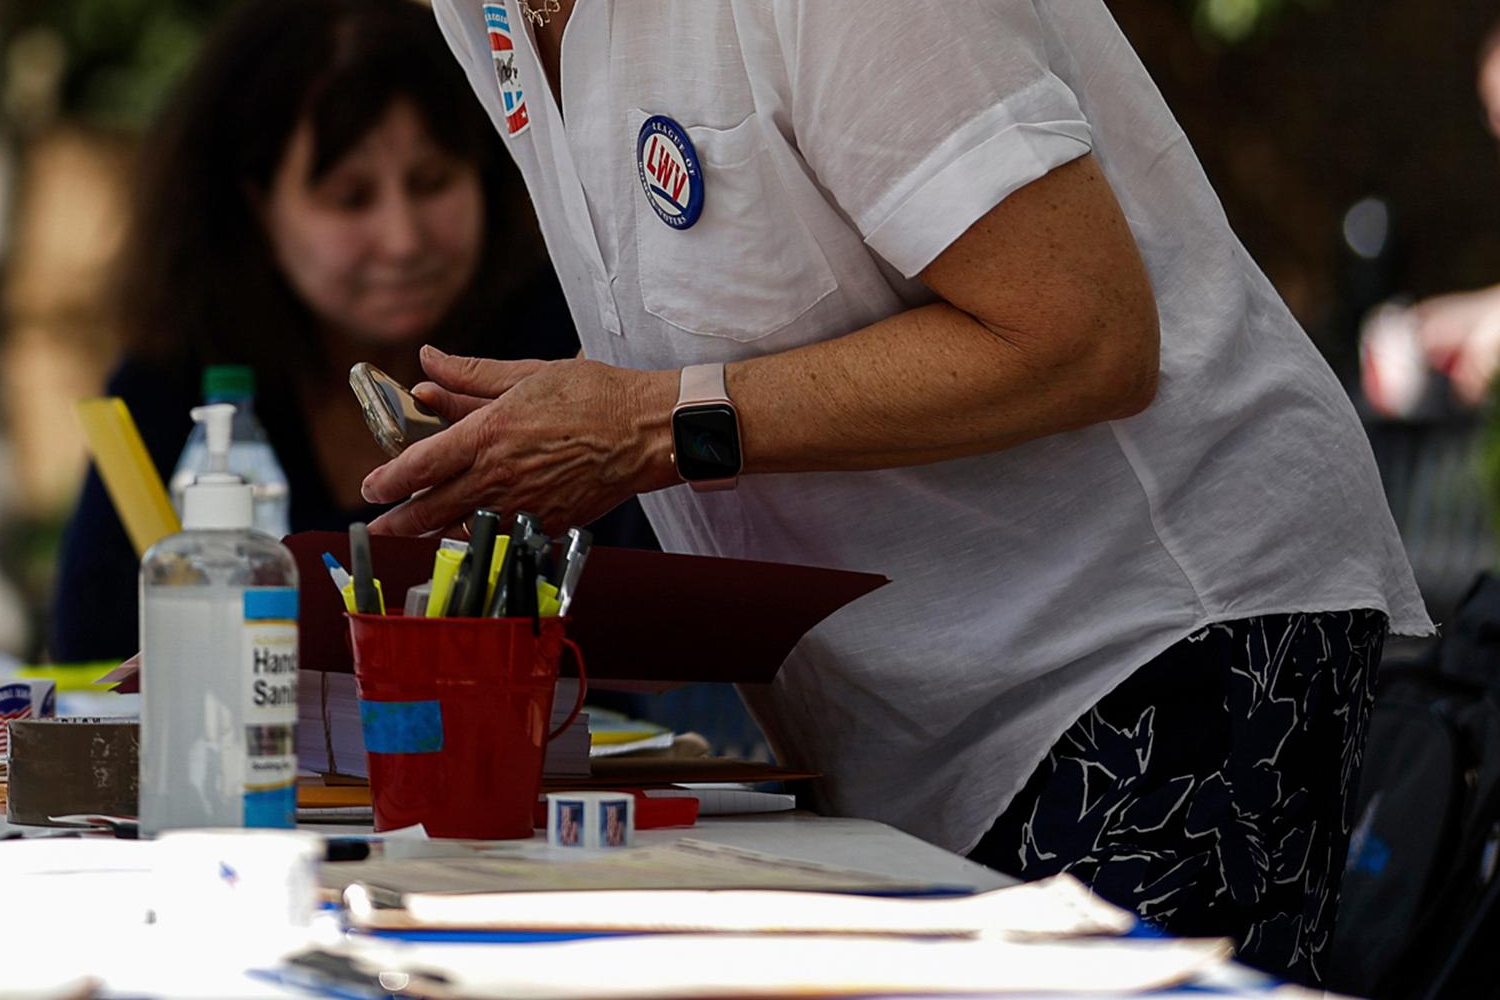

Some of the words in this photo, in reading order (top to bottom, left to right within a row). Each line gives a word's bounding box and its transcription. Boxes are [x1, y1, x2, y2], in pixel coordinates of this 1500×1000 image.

[646, 135, 688, 201] LWV
[652, 122, 686, 150] LEAGUE
[686, 158, 697, 176] OF
